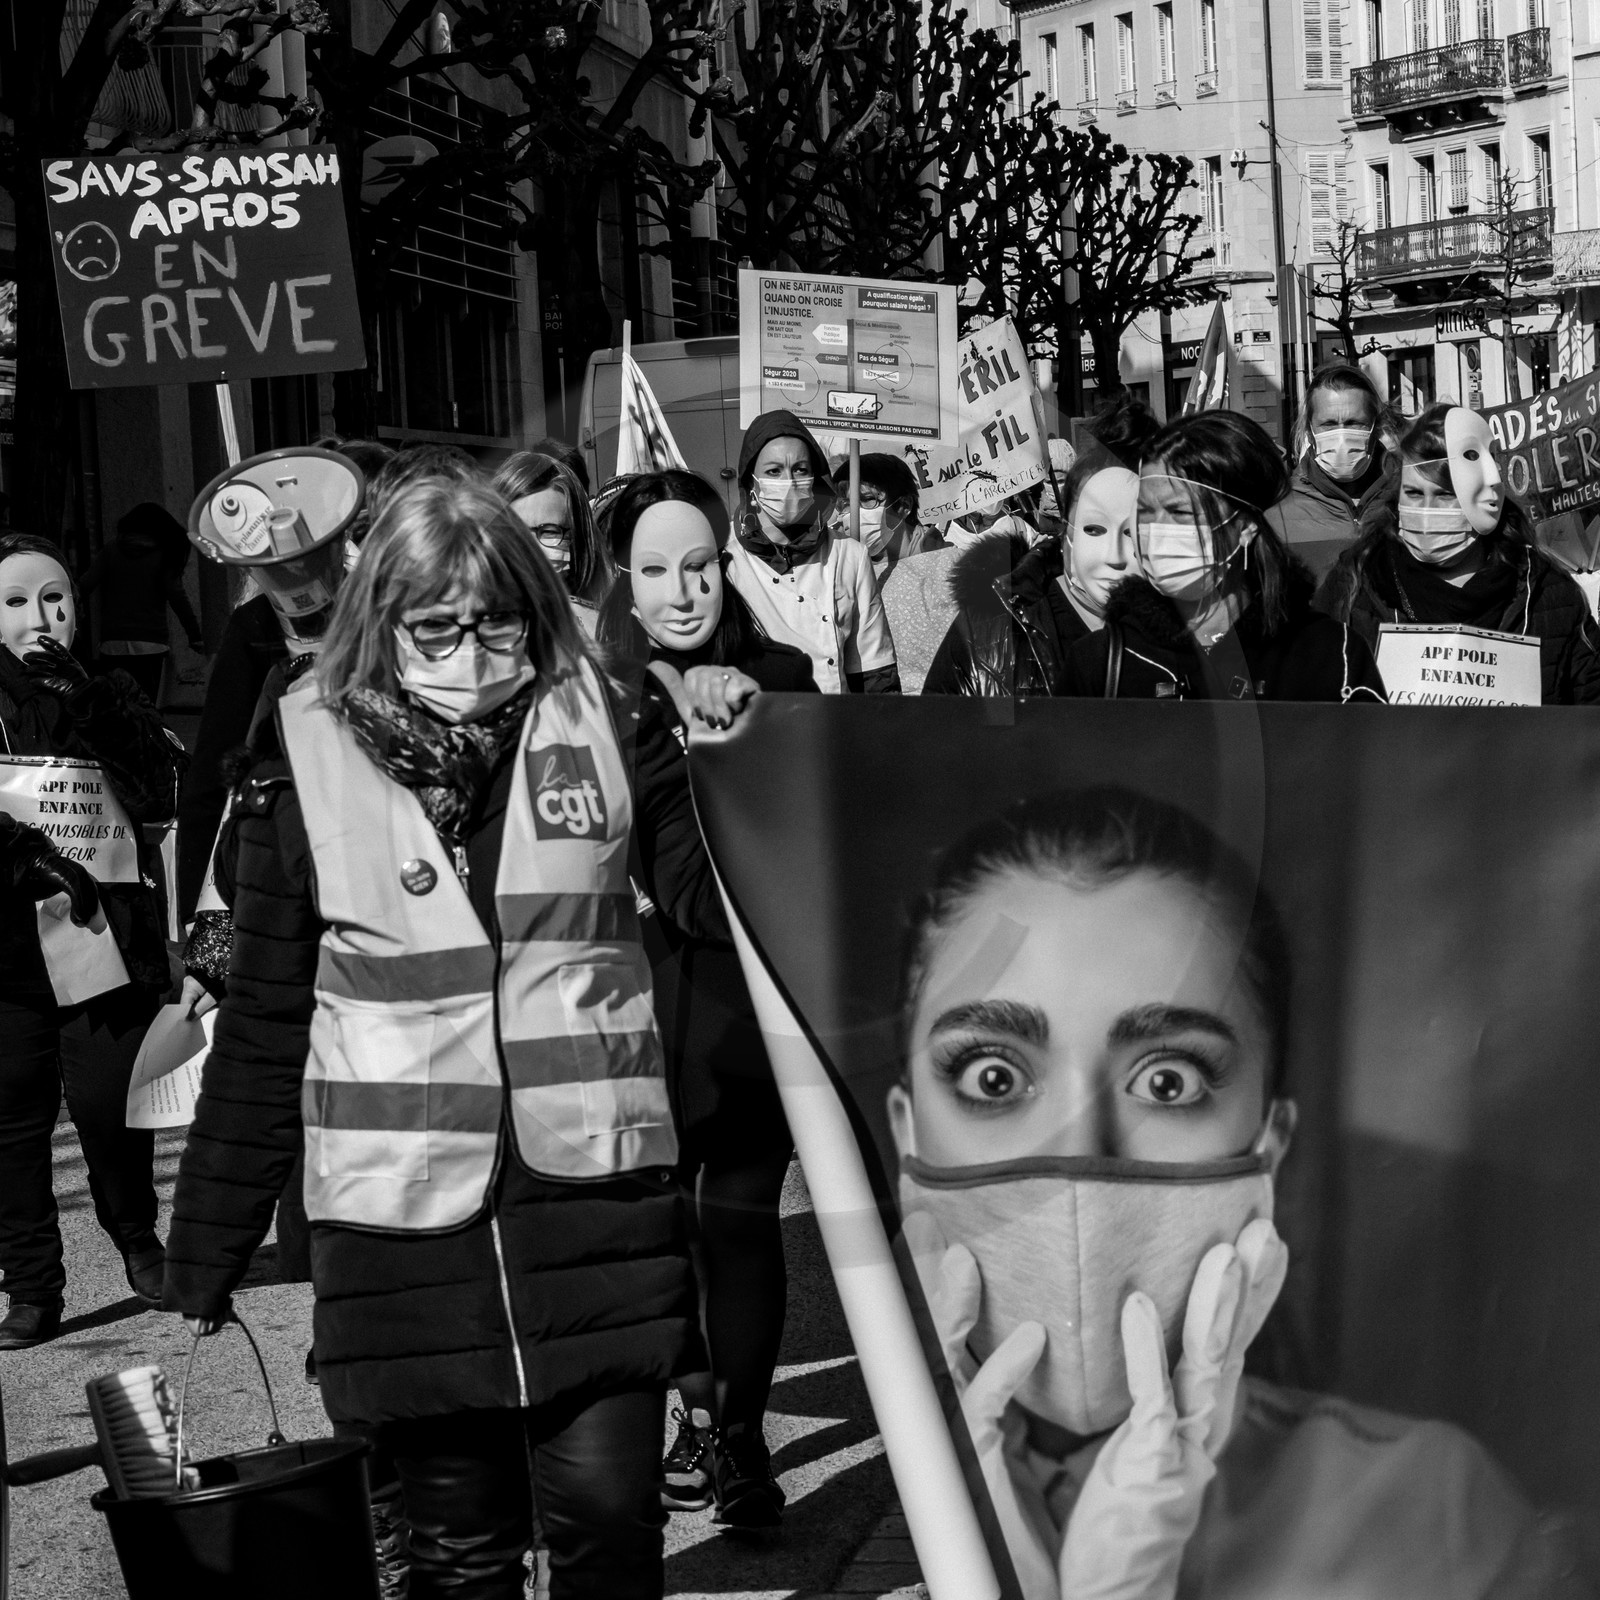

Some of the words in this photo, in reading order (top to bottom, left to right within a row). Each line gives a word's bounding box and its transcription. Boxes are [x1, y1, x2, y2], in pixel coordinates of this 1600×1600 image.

[155, 235, 237, 289] EN
[764, 280, 777, 289] ON
[780, 281, 791, 290] NE
[793, 282, 811, 292] SAIT
[813, 284, 844, 294] JAMAIS
[764, 293, 796, 304] QUAND
[798, 295, 811, 305] ON
[813, 297, 843, 307] CROISE
[873, 292, 908, 300] qualification
[764, 306, 814, 318] L'INJUSTICE.
[862, 300, 889, 308] pourquoi
[908, 303, 926, 311] inégal
[84, 274, 338, 367] GREVE
[1181, 343, 1202, 360] NOC
[878, 355, 895, 364] Ségur
[764, 368, 781, 377] Ségur
[782, 370, 797, 378] 2020
[958, 346, 1020, 404] ÉRIL
[876, 424, 901, 432] LAISSONS
[912, 427, 933, 435] DIVISER.
[1488, 395, 1562, 451] ADÉS
[1564, 407, 1581, 425] du
[938, 458, 963, 483] sur
[965, 442, 983, 469] le
[1420, 646, 1453, 660] APF
[1457, 648, 1498, 666] POLE
[1420, 668, 1496, 688] ENFANCE
[38, 780, 68, 793] APF
[72, 782, 103, 795] POLE
[39, 800, 103, 815] ENFANCE
[537, 779, 604, 835] cgt
[112, 825, 128, 840] DE
